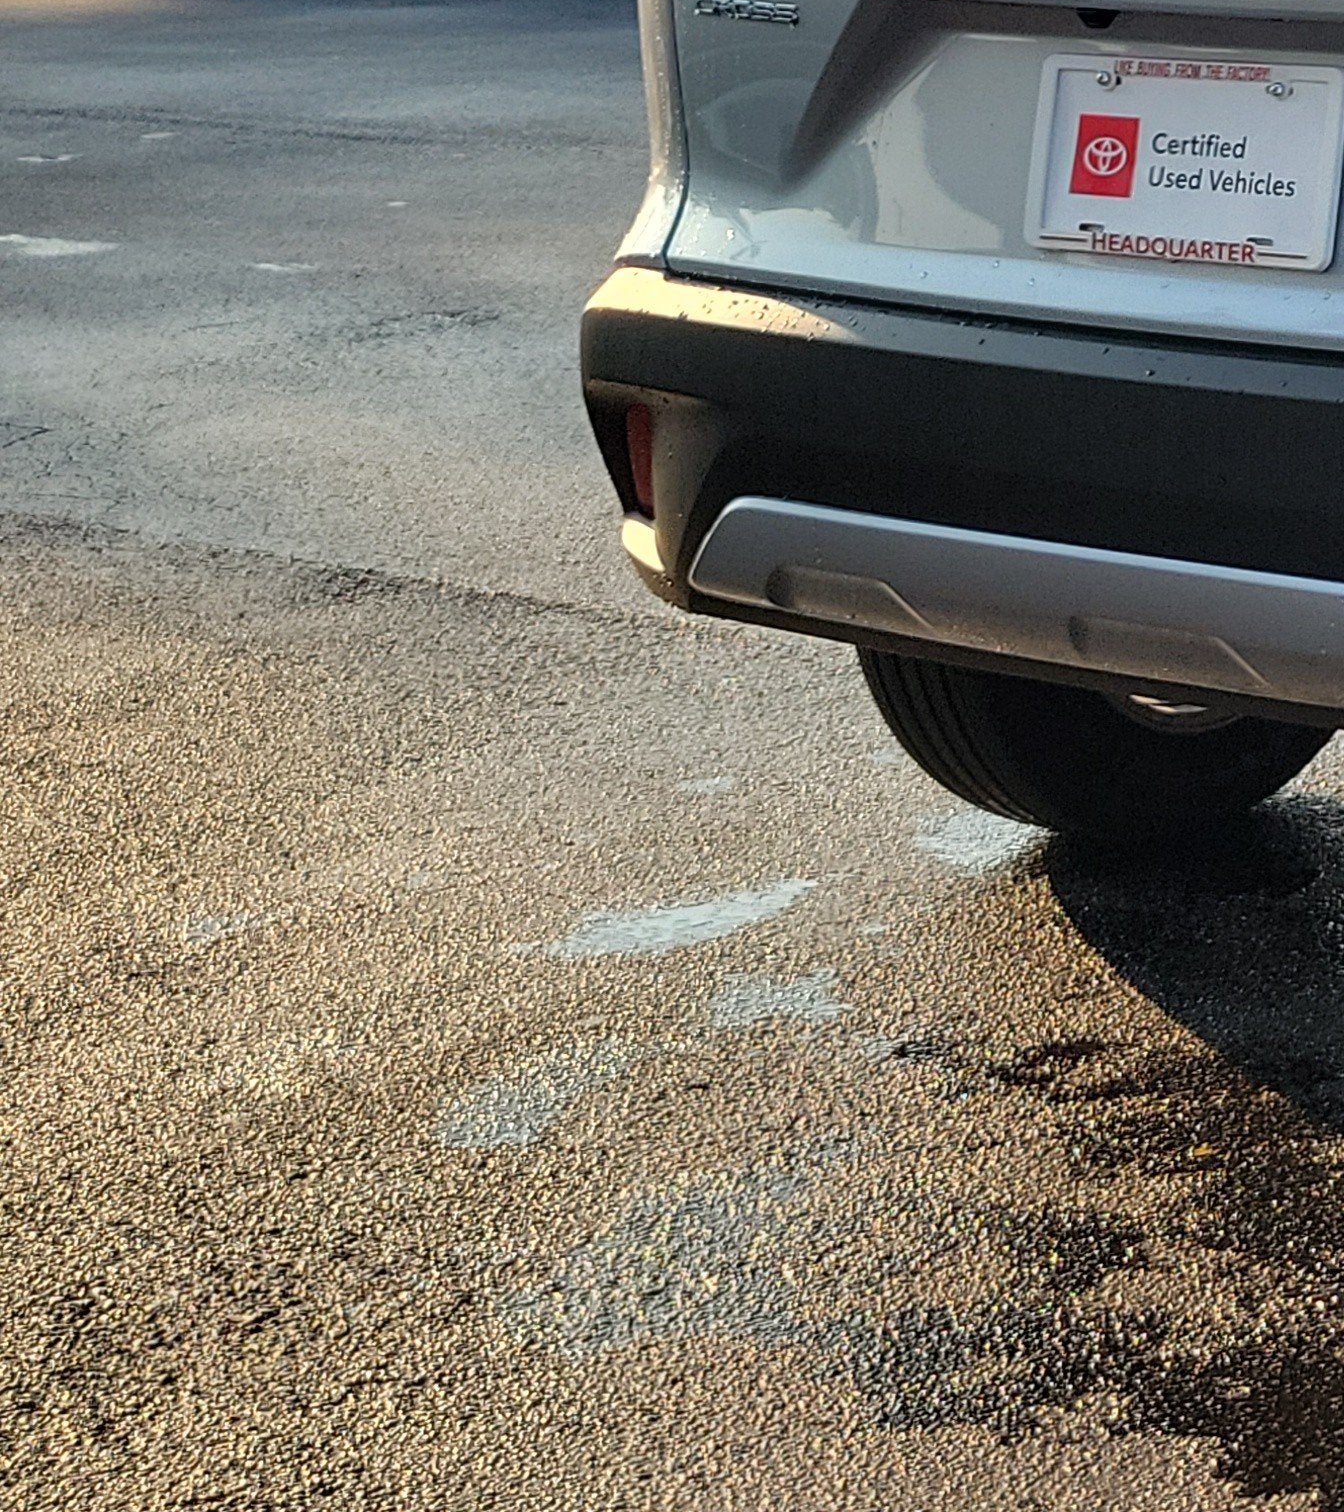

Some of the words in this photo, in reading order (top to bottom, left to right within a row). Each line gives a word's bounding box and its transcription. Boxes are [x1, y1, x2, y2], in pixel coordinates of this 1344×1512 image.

[1175, 63, 1202, 79] FROM
[1206, 65, 1224, 80] THE
[1152, 133, 1247, 159] Certified
[1149, 165, 1203, 189] Used
[1210, 169, 1296, 197] Vehicles
[1091, 231, 1256, 263] HEADQUARTER
